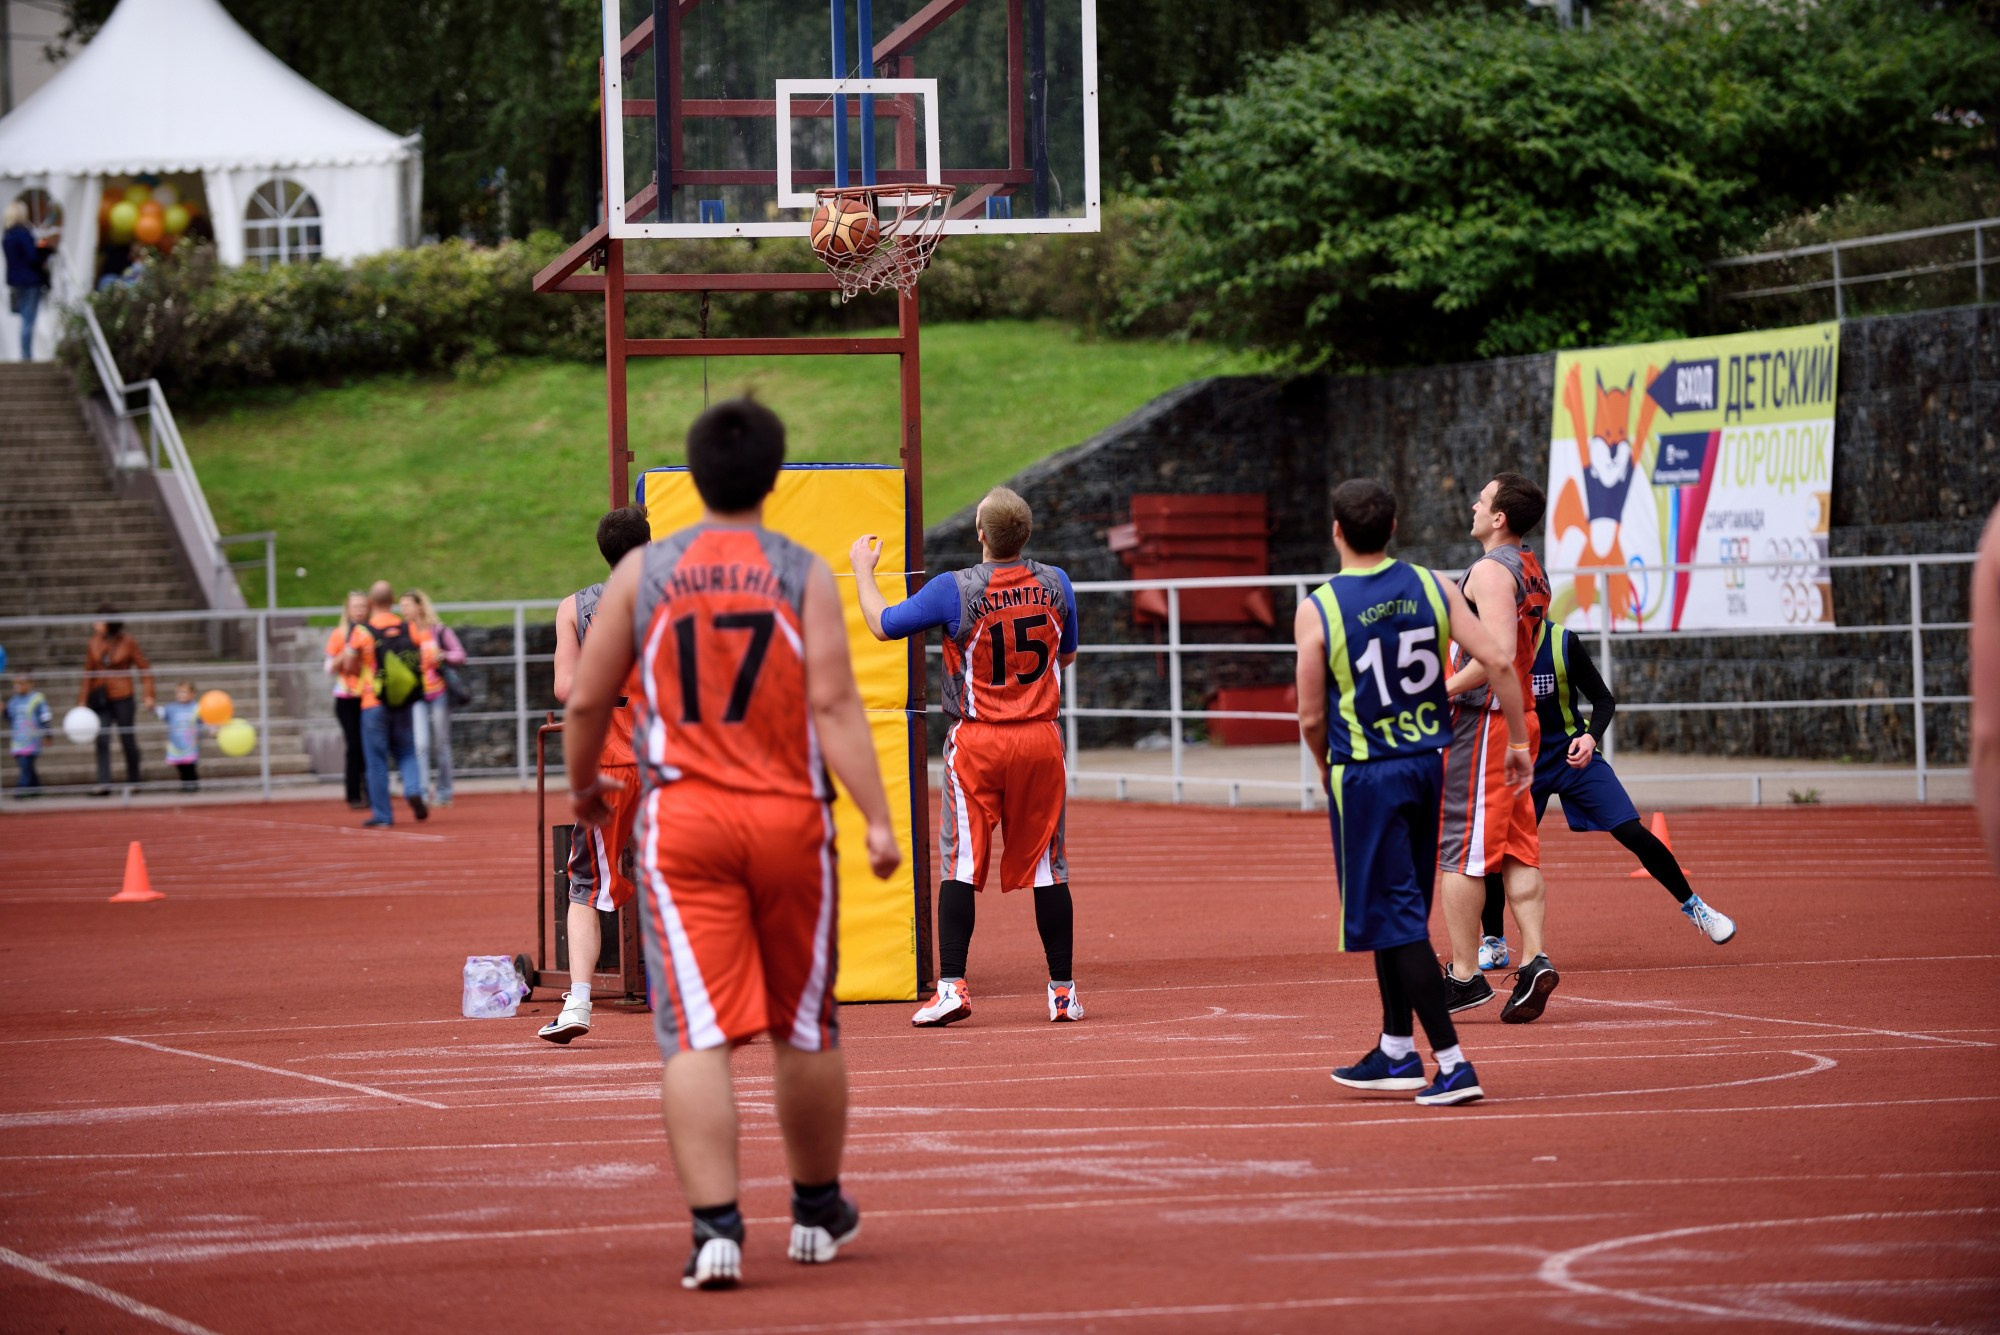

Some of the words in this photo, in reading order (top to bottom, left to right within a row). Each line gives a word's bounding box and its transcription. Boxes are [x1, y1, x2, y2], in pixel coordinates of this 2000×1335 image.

[1676, 363, 1714, 408] ВХОД
[1725, 331, 1833, 421] ДЕТСКИЙ
[1722, 427, 1828, 494] ГОРОДОК
[967, 586, 1060, 620] KAZANTSEV
[1356, 599, 1418, 627] KOROTIN
[672, 608, 776, 725] 17
[986, 612, 1049, 687] 15
[1354, 626, 1440, 707] 15
[1372, 701, 1440, 748] TSC
